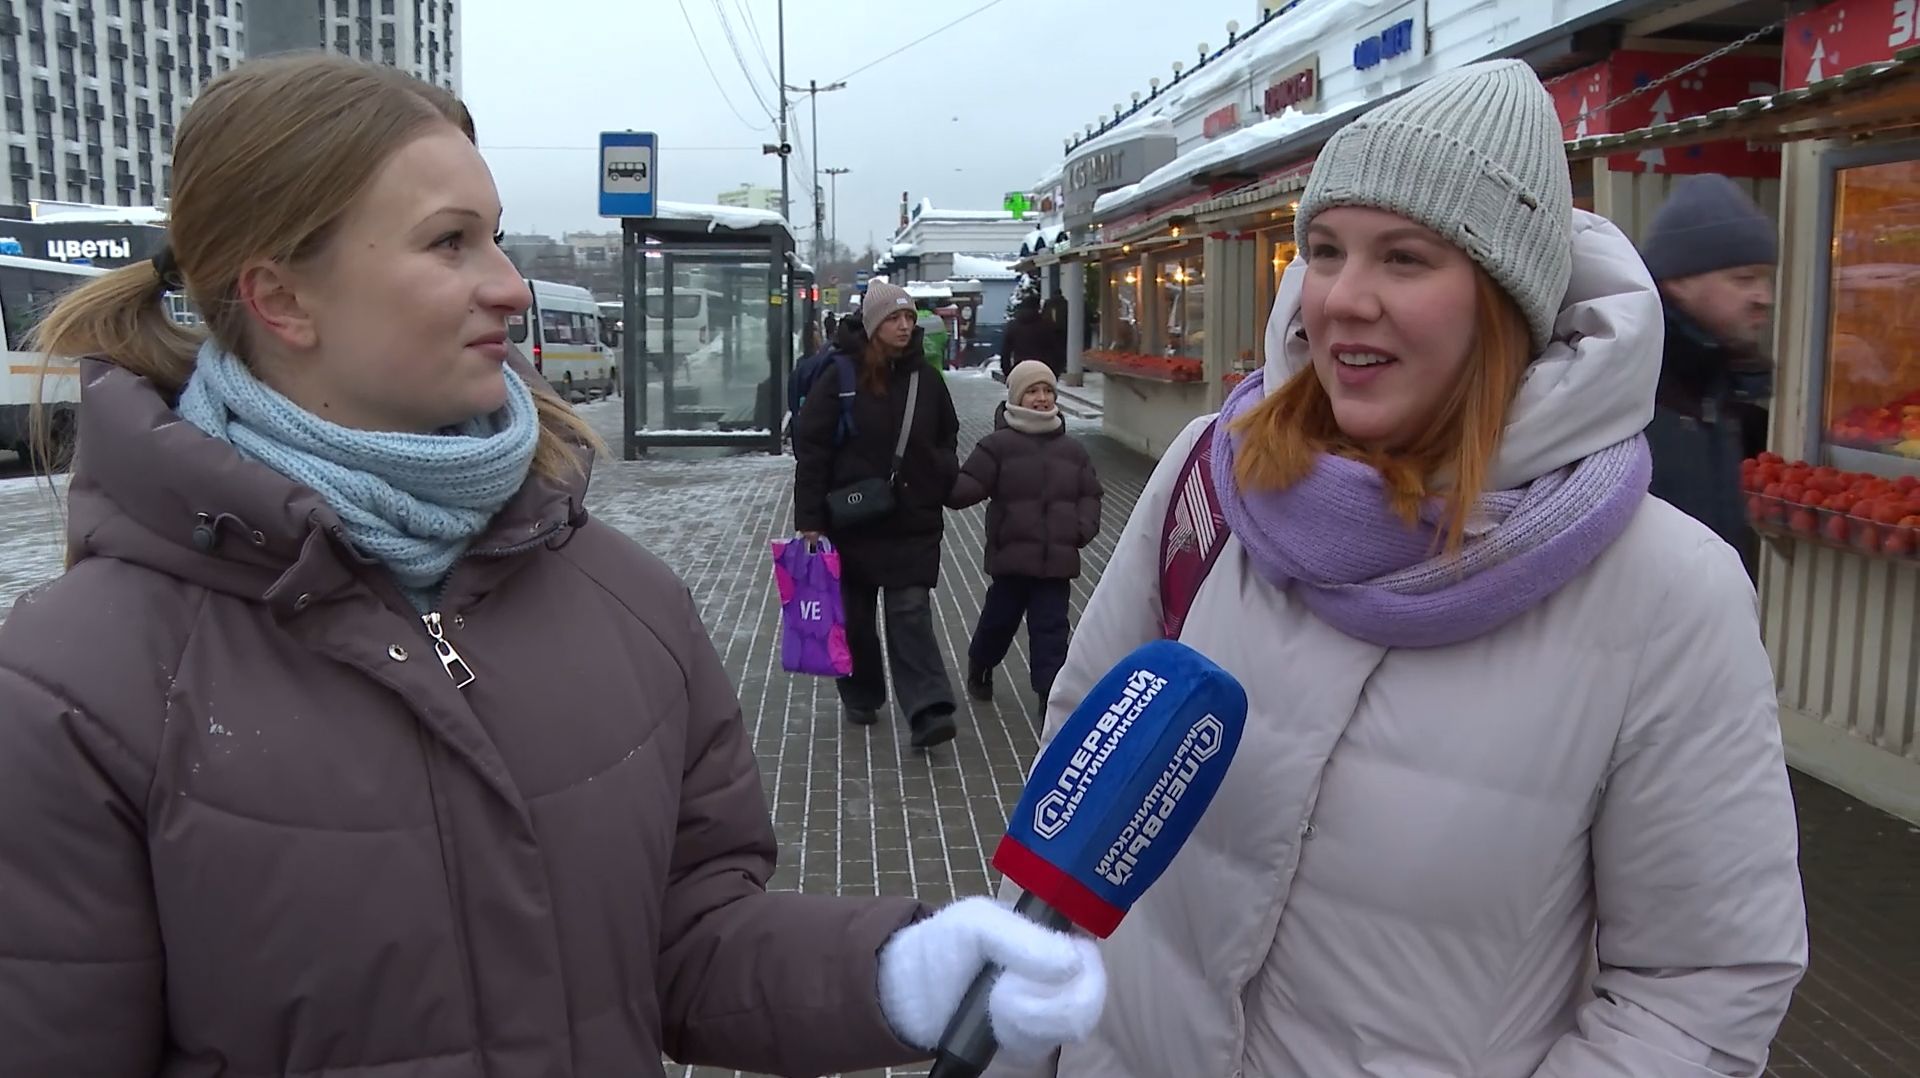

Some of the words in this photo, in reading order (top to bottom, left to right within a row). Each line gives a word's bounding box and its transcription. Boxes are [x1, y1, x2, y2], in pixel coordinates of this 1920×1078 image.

[47, 237, 130, 262] цветы
[1057, 669, 1155, 792] ПЕРВЫЙ
[1060, 677, 1168, 823] МЫТИЩИНСКИЙ
[1095, 727, 1199, 876] МЫТИЩИНСКИЙ
[1106, 757, 1201, 886] ПЕРВЫЙ
